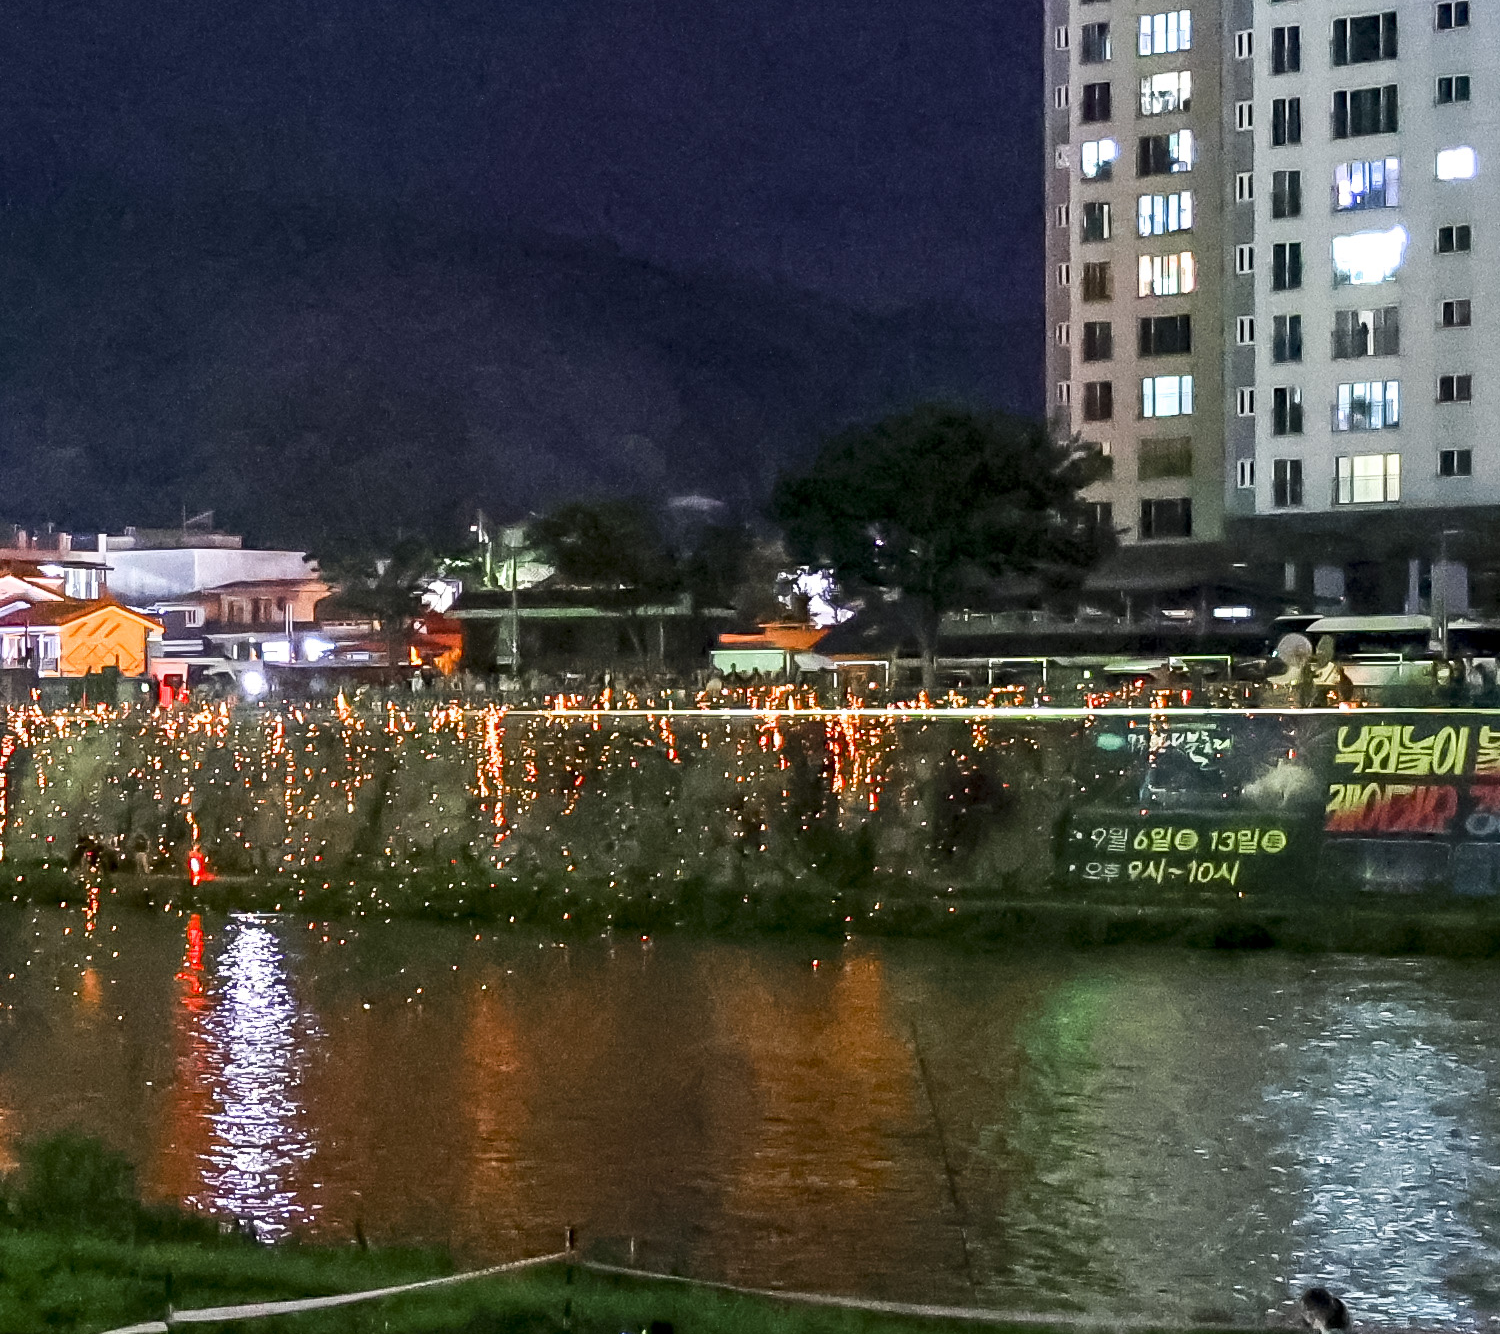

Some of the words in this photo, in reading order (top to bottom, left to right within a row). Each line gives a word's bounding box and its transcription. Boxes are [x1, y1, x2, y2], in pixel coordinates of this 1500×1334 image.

[1335, 725, 1469, 775] 낙화놀이
[1091, 828, 1128, 851] 9월
[1082, 862, 1121, 883] 오후
